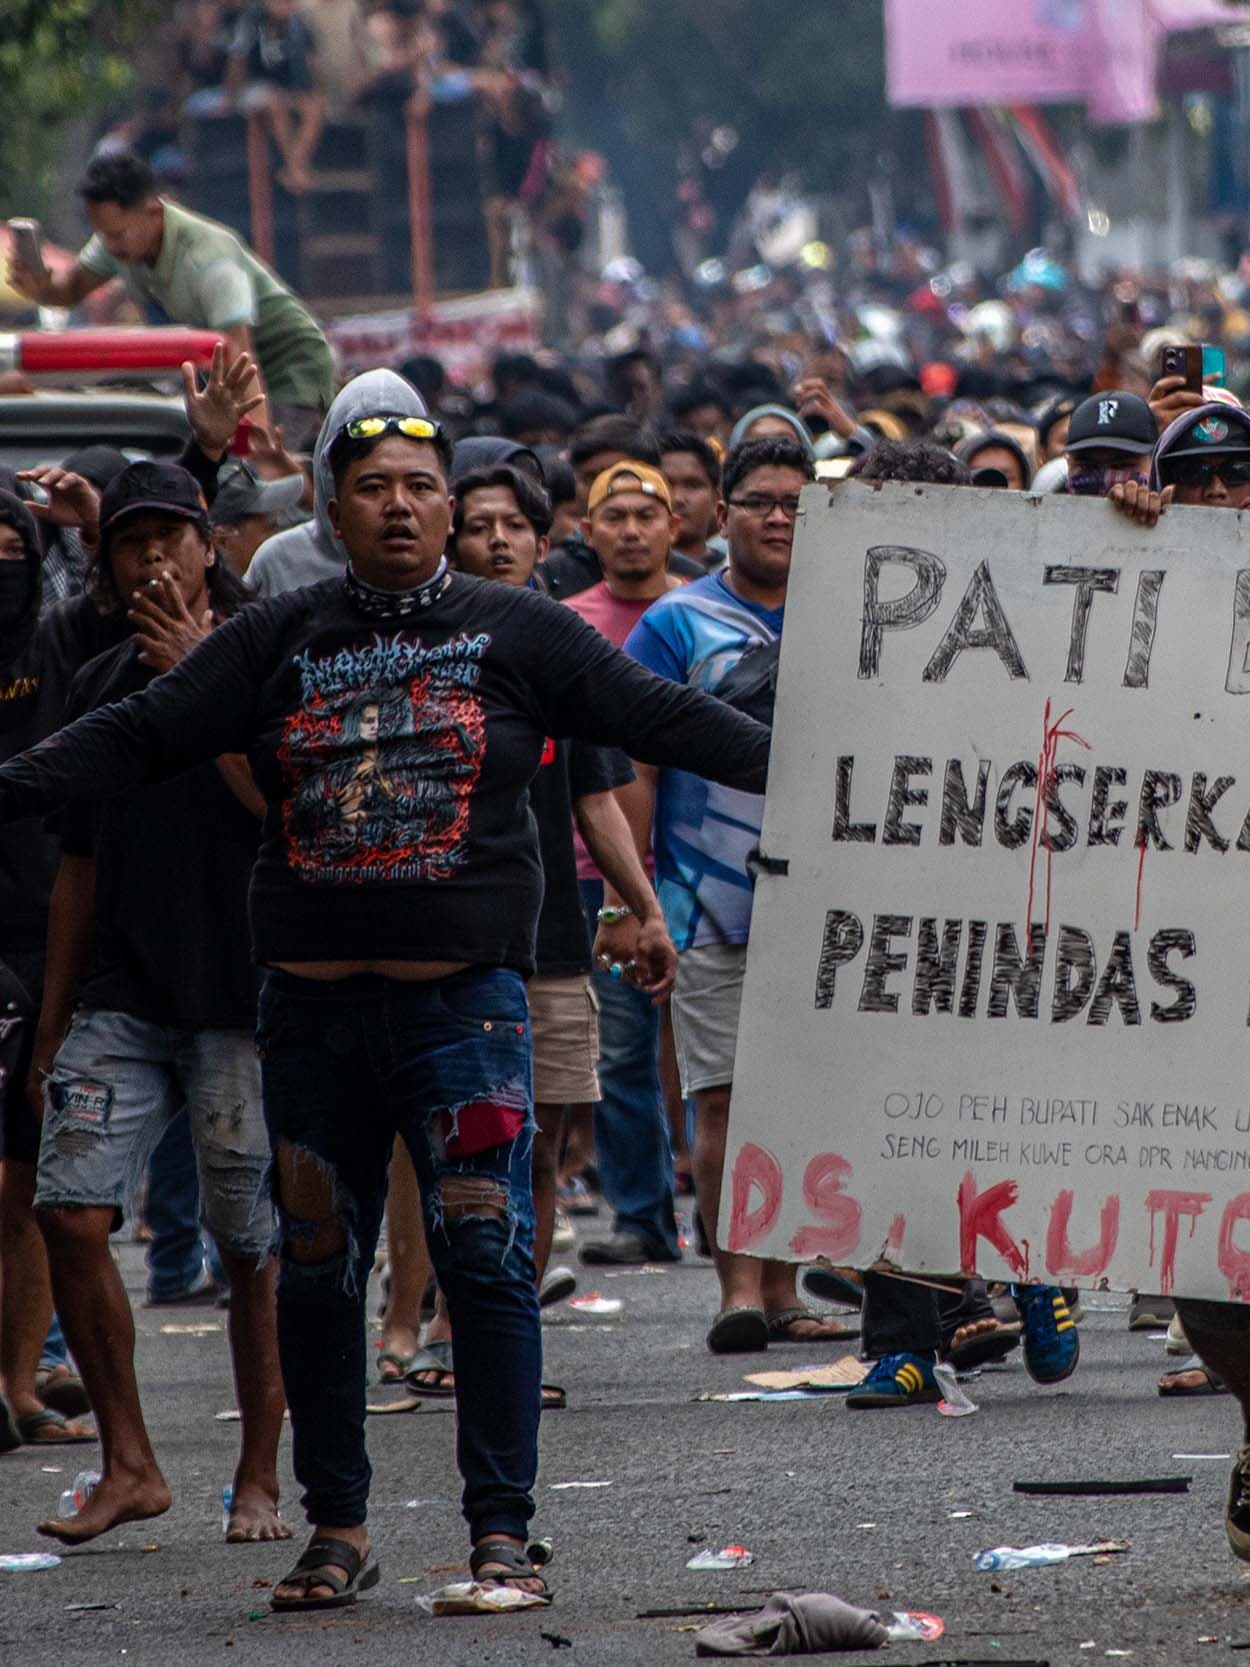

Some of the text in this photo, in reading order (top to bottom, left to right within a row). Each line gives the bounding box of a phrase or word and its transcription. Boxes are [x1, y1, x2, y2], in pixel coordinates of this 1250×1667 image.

[856, 545, 1167, 689] PATI
[883, 1091, 944, 1121] OJO
[958, 1094, 1008, 1123] PEH
[1020, 1097, 1098, 1128] BUPATI
[1114, 1101, 1153, 1128] SAK
[1162, 1103, 1218, 1133] ENAK
[951, 1138, 1010, 1164] MILEH
[1020, 1142, 1073, 1168] KUWE
[1085, 1144, 1128, 1167] ORA
[1139, 1144, 1173, 1169] DPR
